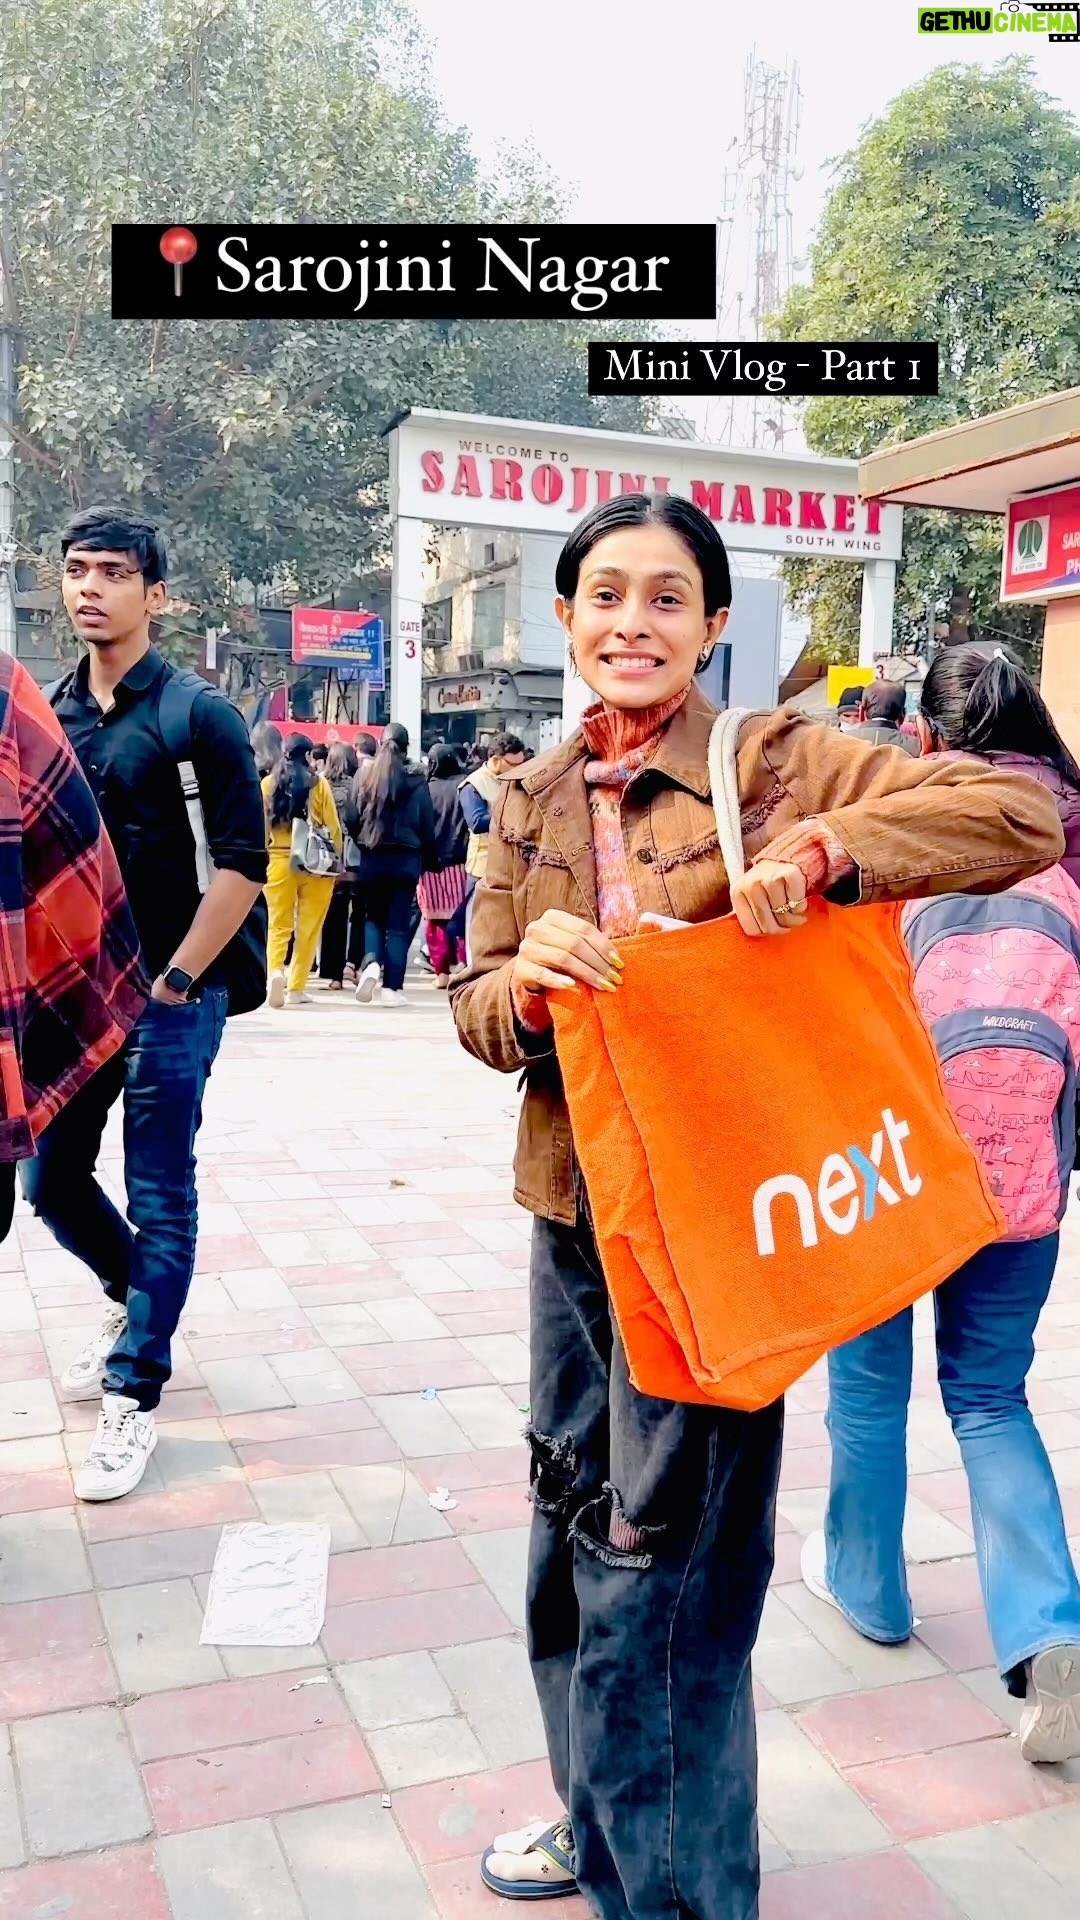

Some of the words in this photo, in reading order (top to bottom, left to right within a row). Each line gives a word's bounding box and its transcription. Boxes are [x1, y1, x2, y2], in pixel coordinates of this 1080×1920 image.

[459, 440, 543, 460] WELCOME
[550, 451, 570, 463] TO
[690, 479, 886, 535] MARKET
[785, 535, 835, 547] SOUTH
[844, 539, 881, 551] WING
[400, 621, 421, 633] GATE
[405, 640, 416, 659] 3
[982, 1015, 1038, 1031] WILDCRAFT
[753, 1107, 923, 1257] next
